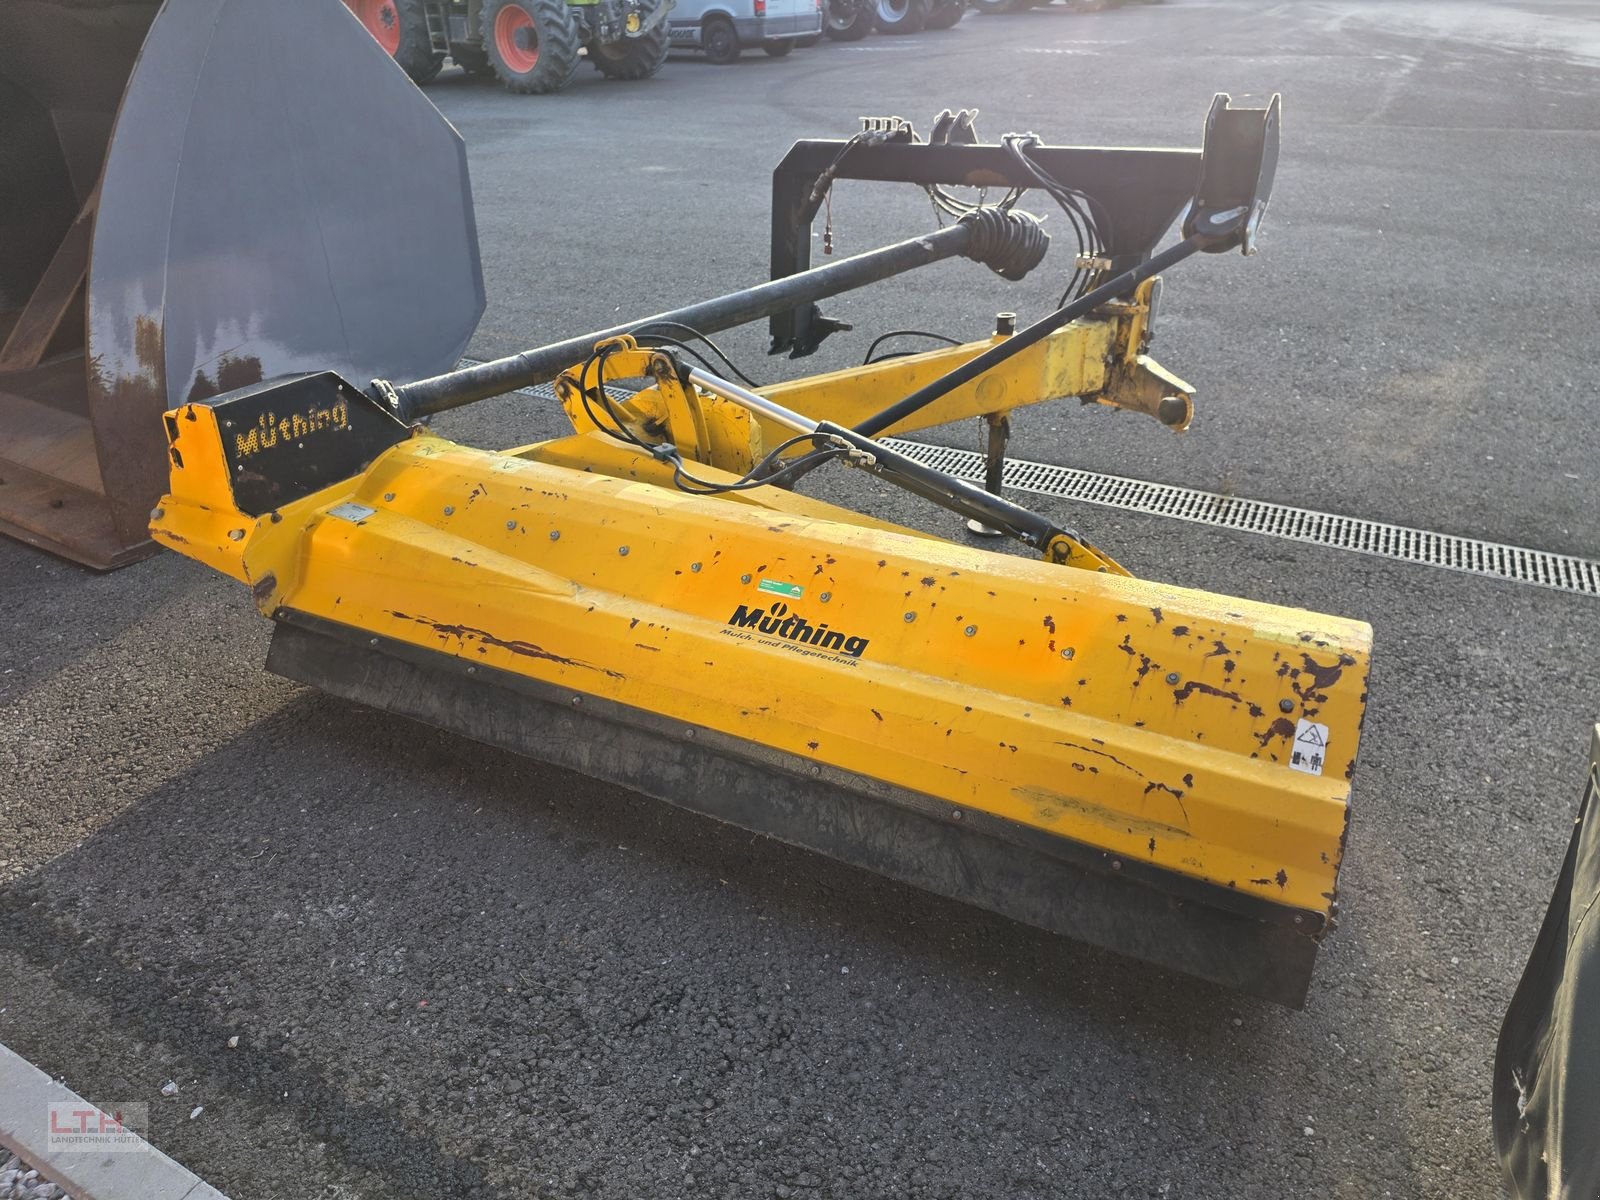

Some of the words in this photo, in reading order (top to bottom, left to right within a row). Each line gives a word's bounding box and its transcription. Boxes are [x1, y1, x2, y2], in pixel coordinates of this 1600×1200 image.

[237, 404, 348, 457] Müthing
[719, 629, 755, 641] Mulch-
[757, 638, 781, 648] und
[782, 643, 860, 668] Pflegetechnik
[728, 602, 870, 657] Müthing
